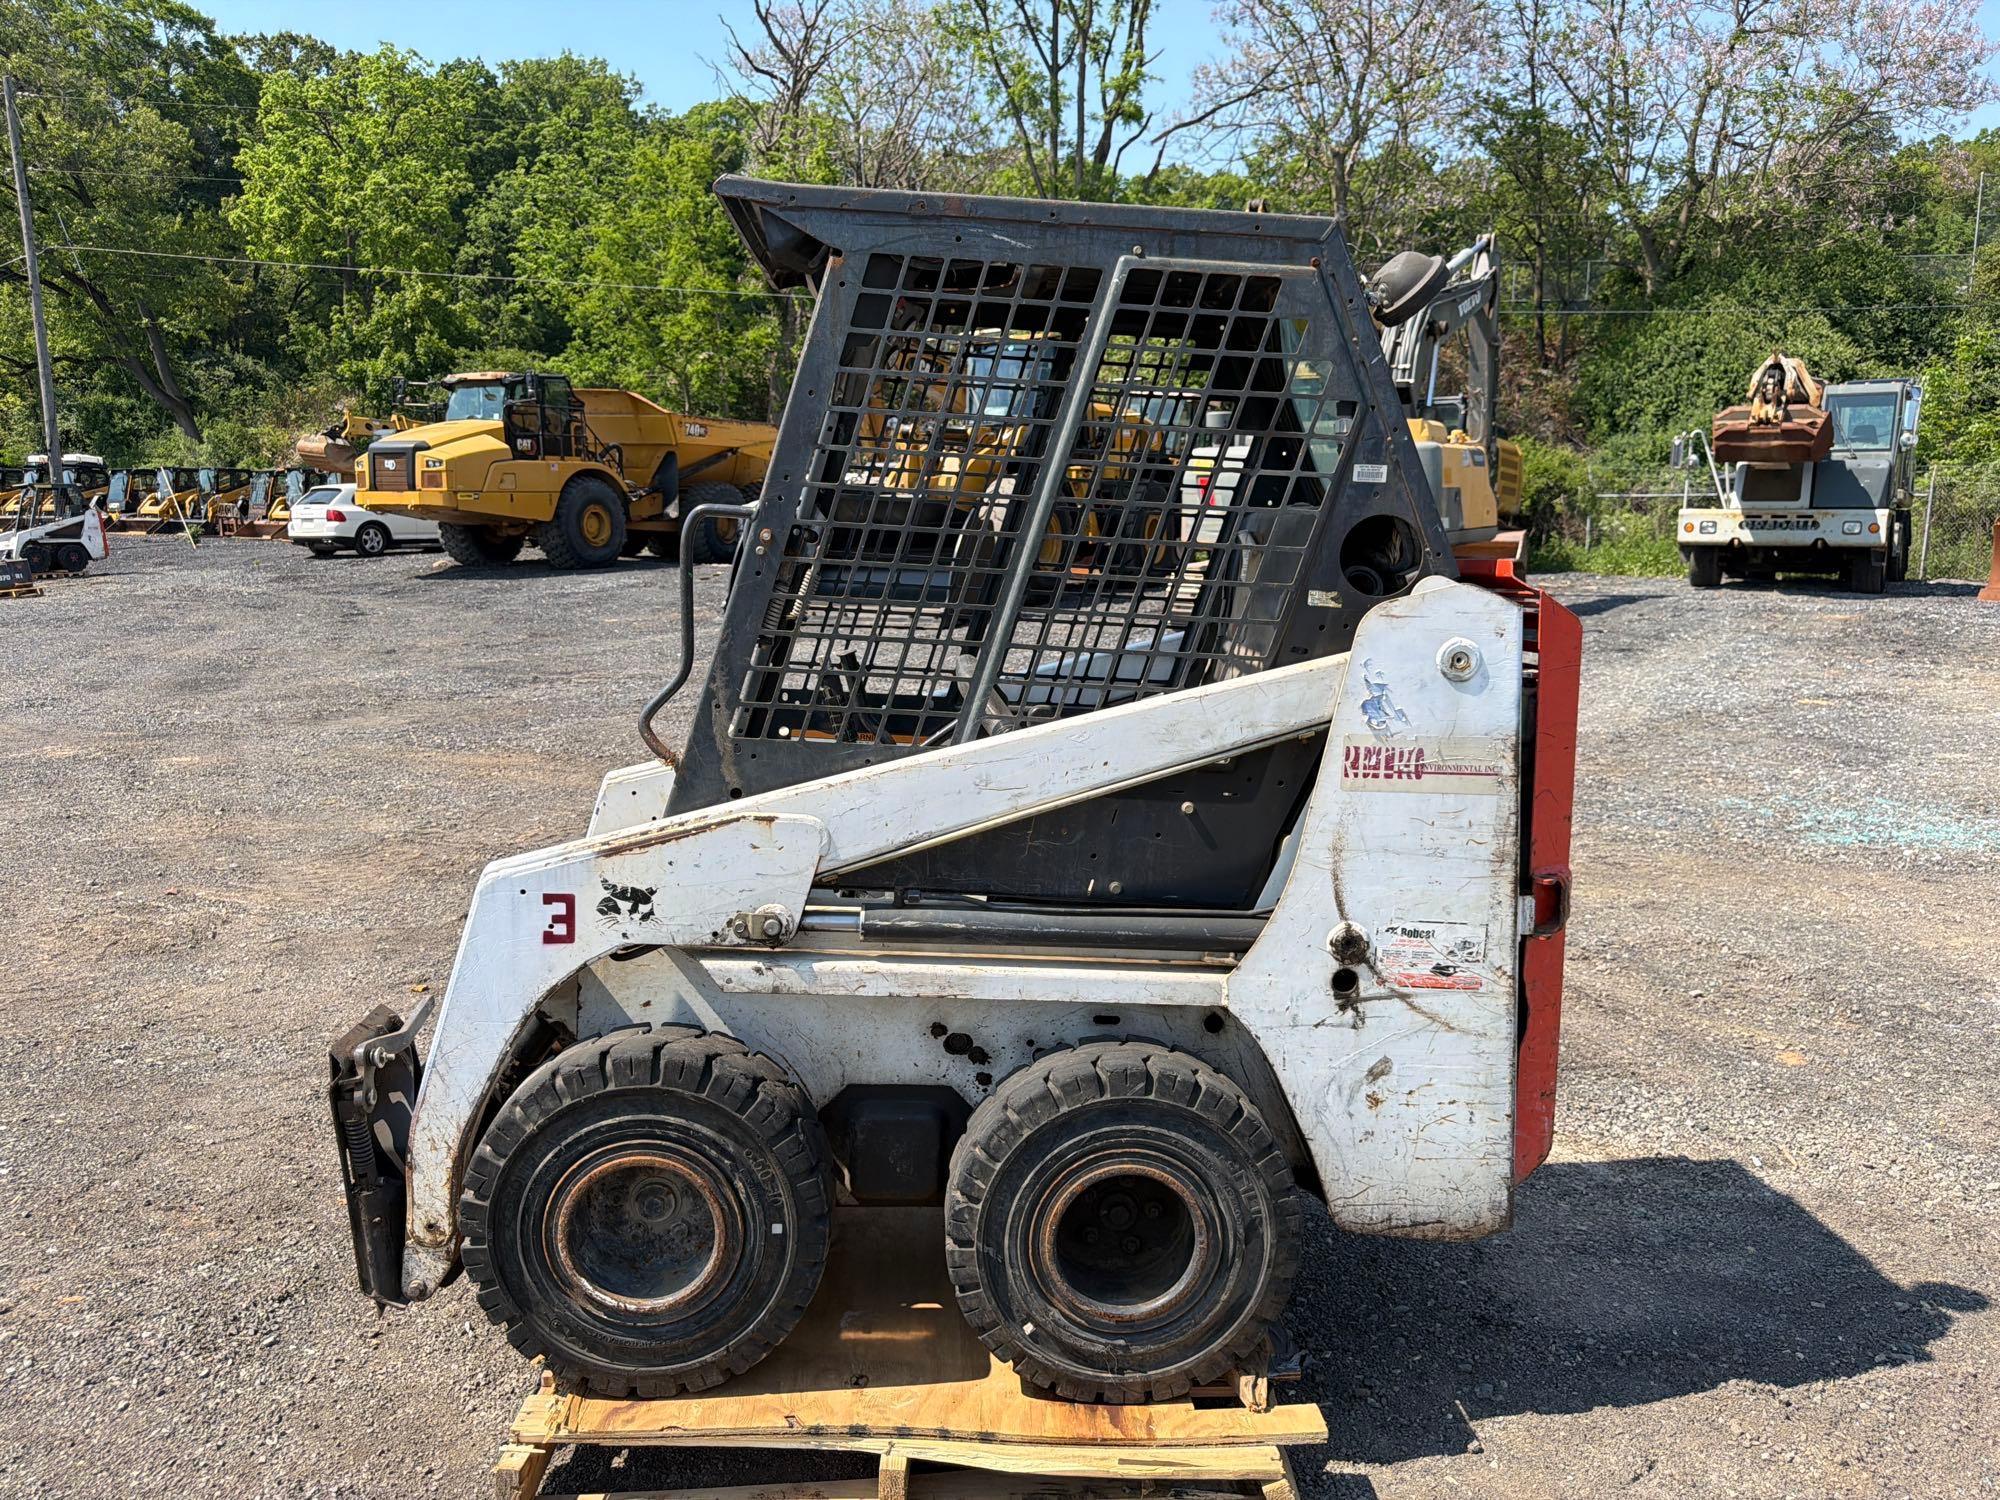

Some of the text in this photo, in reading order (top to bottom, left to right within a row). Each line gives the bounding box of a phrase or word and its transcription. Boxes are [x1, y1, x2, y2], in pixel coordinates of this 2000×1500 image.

[1458, 290, 1482, 317] VOLVO
[517, 438, 532, 451] CAT
[543, 893, 575, 944] 3
[1400, 927, 1436, 939] Bobcat
